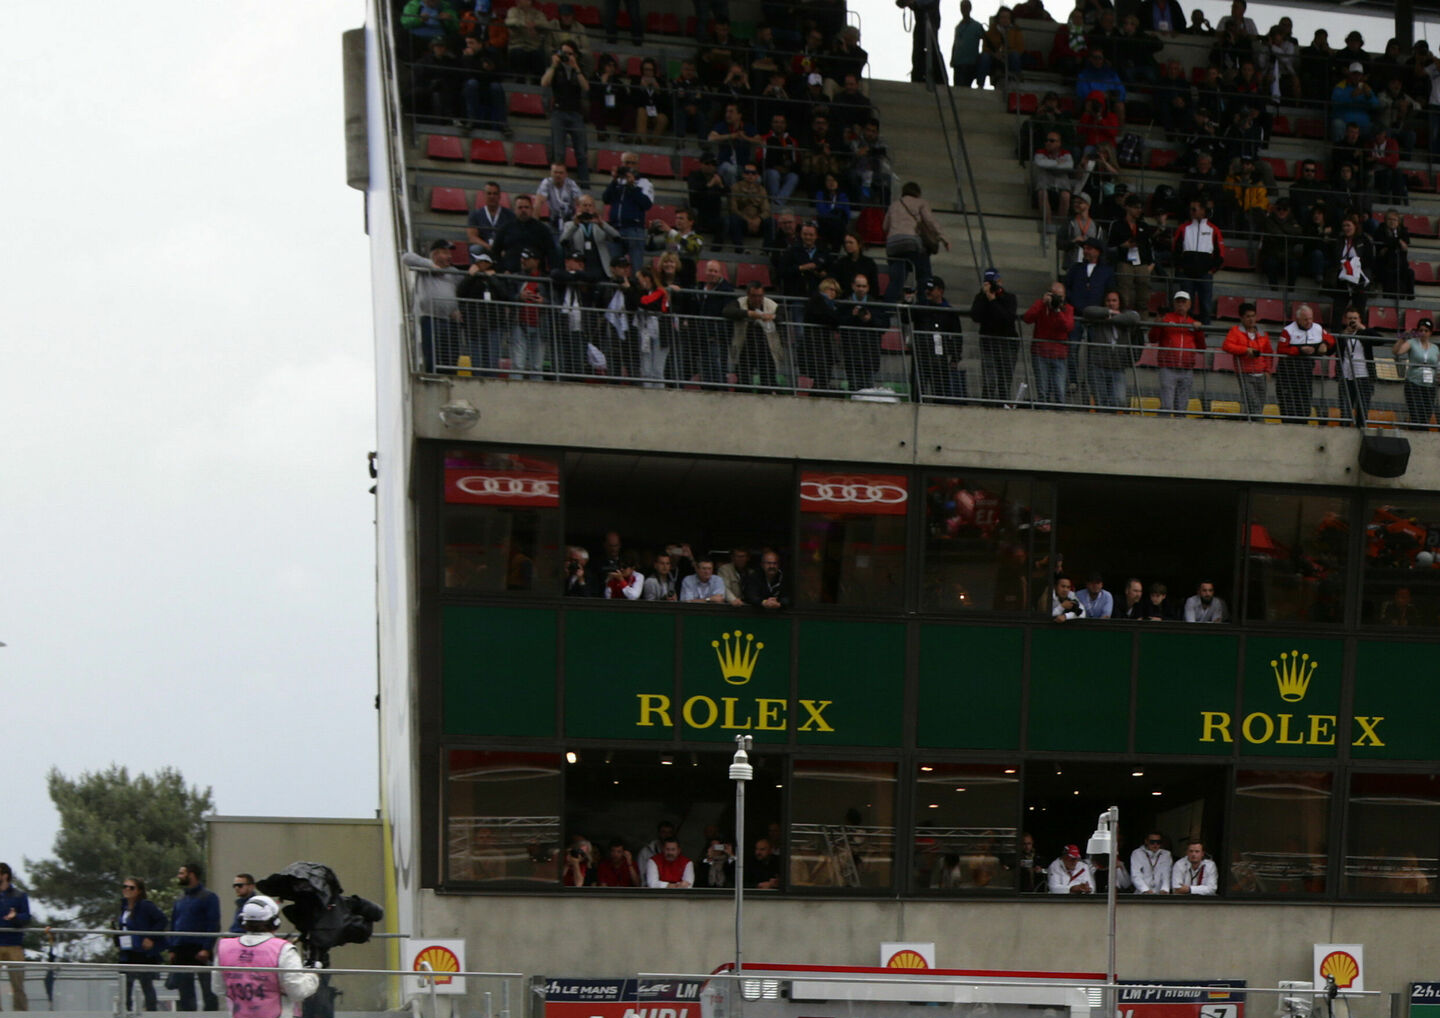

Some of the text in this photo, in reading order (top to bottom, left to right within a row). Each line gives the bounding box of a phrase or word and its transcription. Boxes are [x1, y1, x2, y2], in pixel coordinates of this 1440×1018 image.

[636, 694, 834, 731] ROLEX
[1199, 711, 1385, 747] ROLEX
[562, 986, 578, 994] LE
[579, 986, 618, 994] MANS
[675, 983, 698, 998] LM
